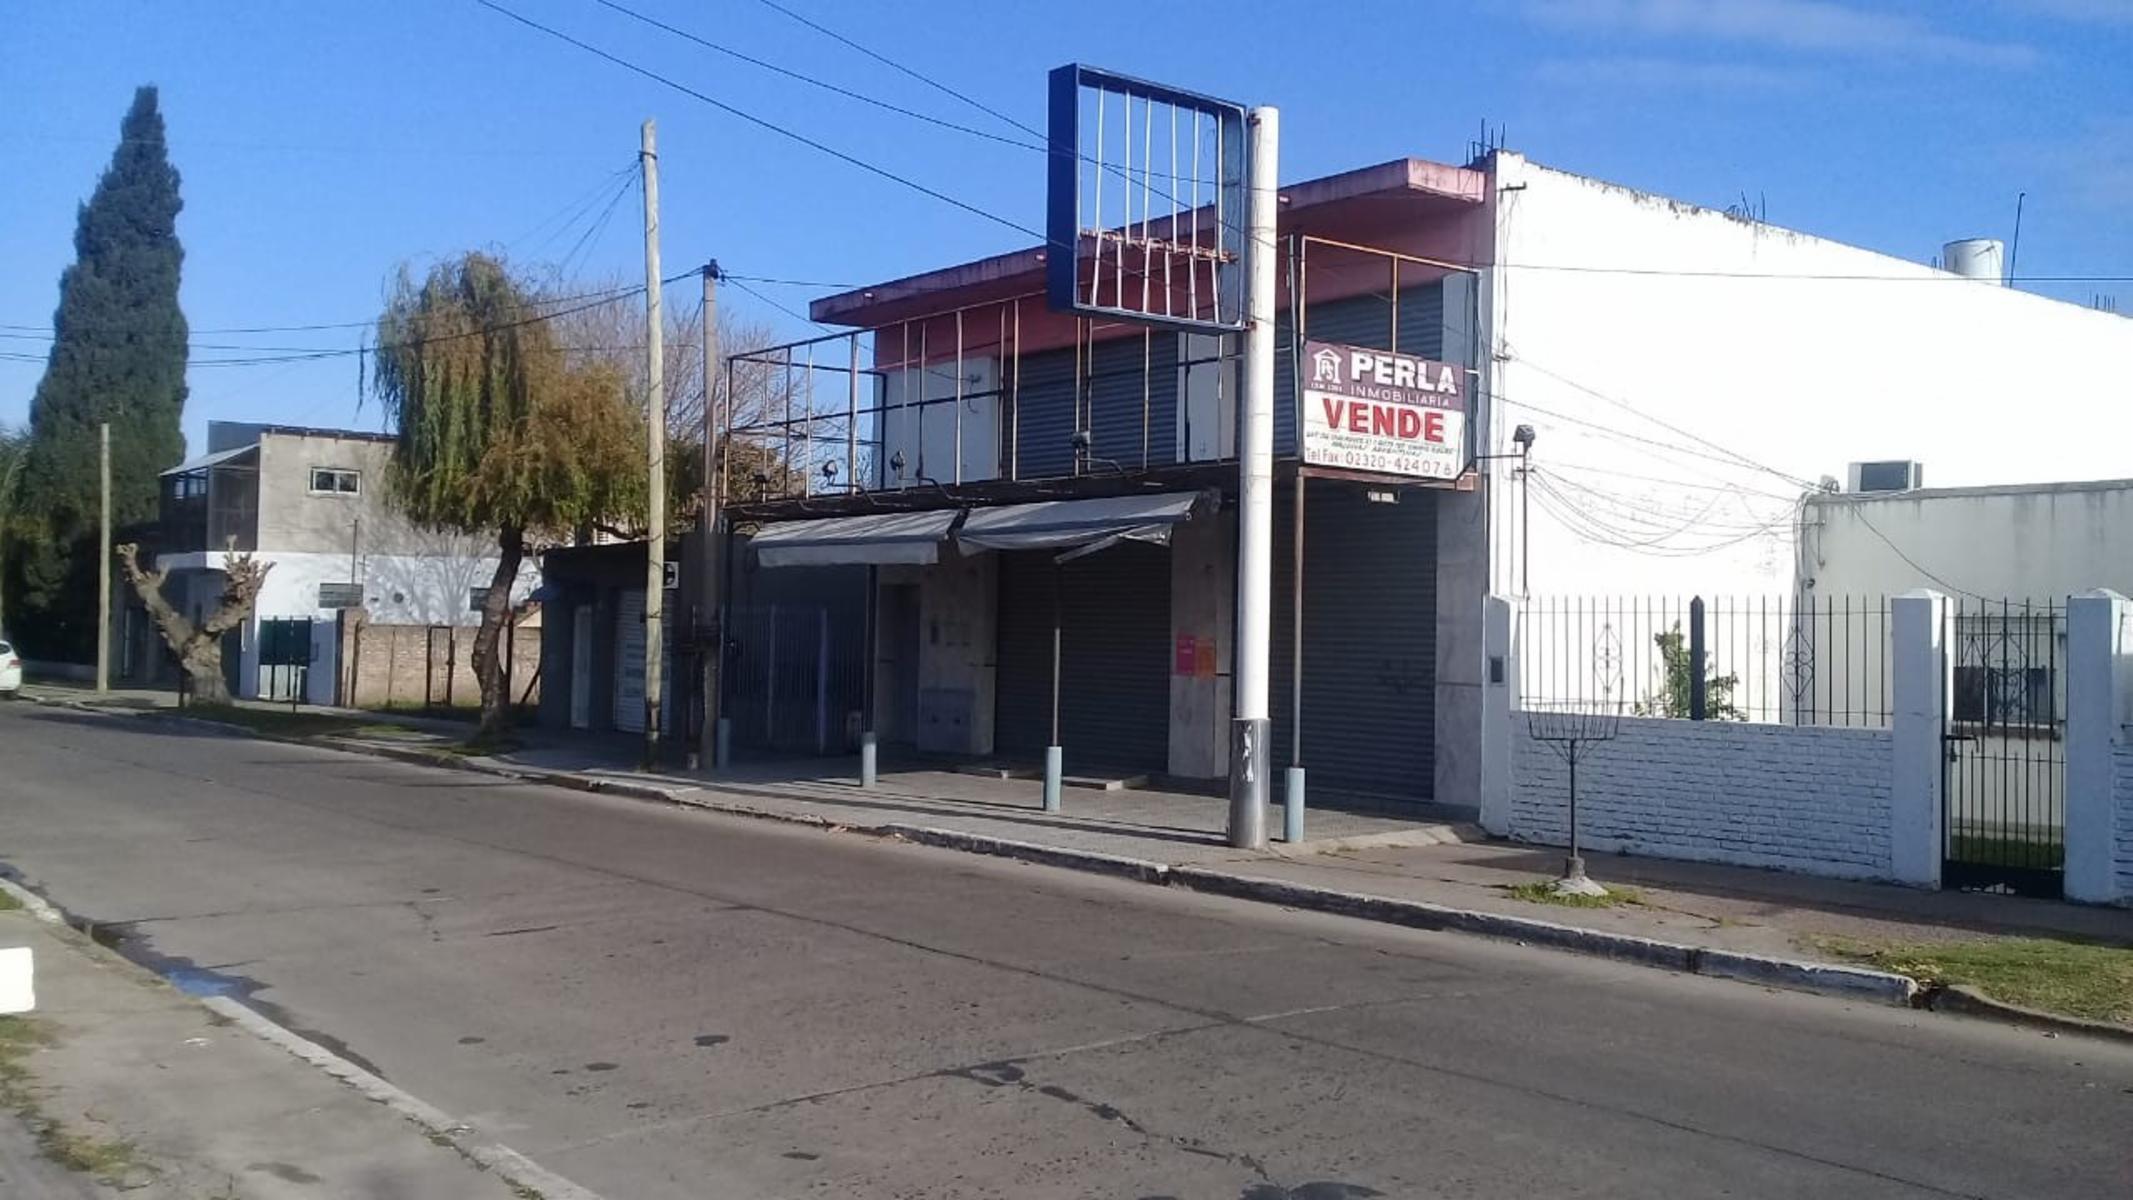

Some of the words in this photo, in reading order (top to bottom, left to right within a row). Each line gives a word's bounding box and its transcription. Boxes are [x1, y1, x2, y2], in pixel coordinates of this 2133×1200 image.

[1351, 352, 1457, 394] PERLA
[1350, 384, 1449, 407] INMOBILIARIA
[1322, 398, 1444, 443] VENDE
